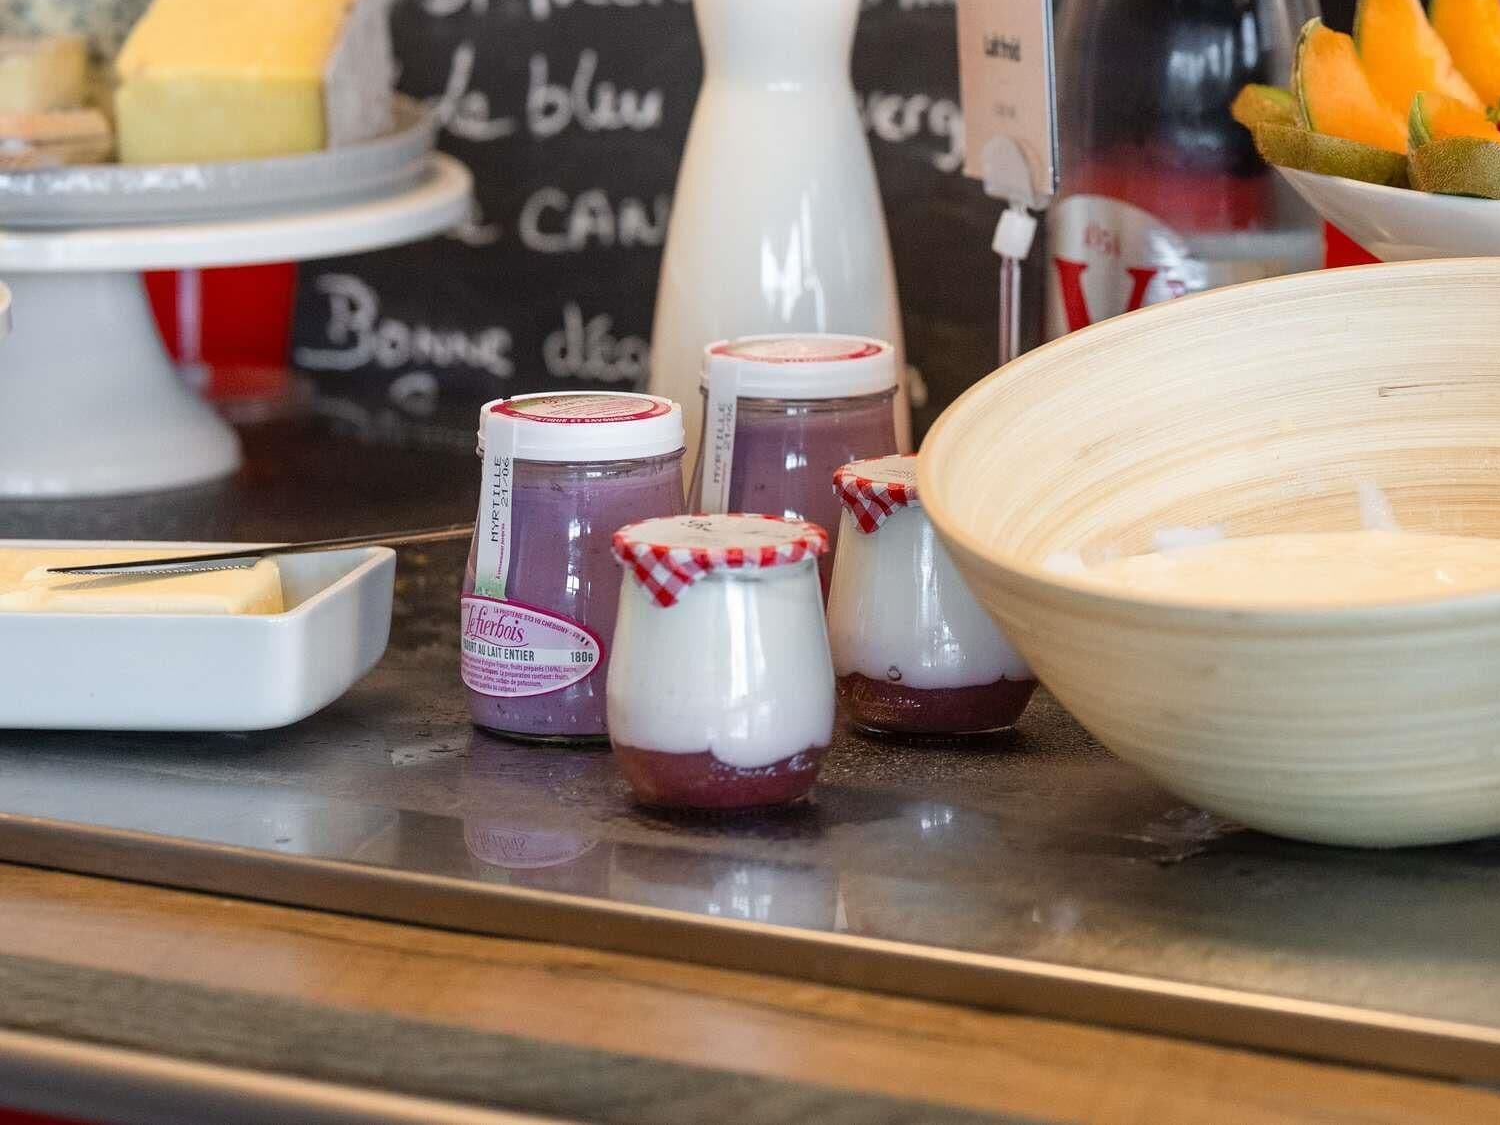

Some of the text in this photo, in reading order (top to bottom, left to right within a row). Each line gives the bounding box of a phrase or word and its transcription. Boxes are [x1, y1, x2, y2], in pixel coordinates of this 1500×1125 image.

[491, 456, 501, 543] MYRTILLE
[501, 457, 510, 508] 21/06
[487, 646, 503, 659] LAIT
[504, 649, 535, 663] ENTIER
